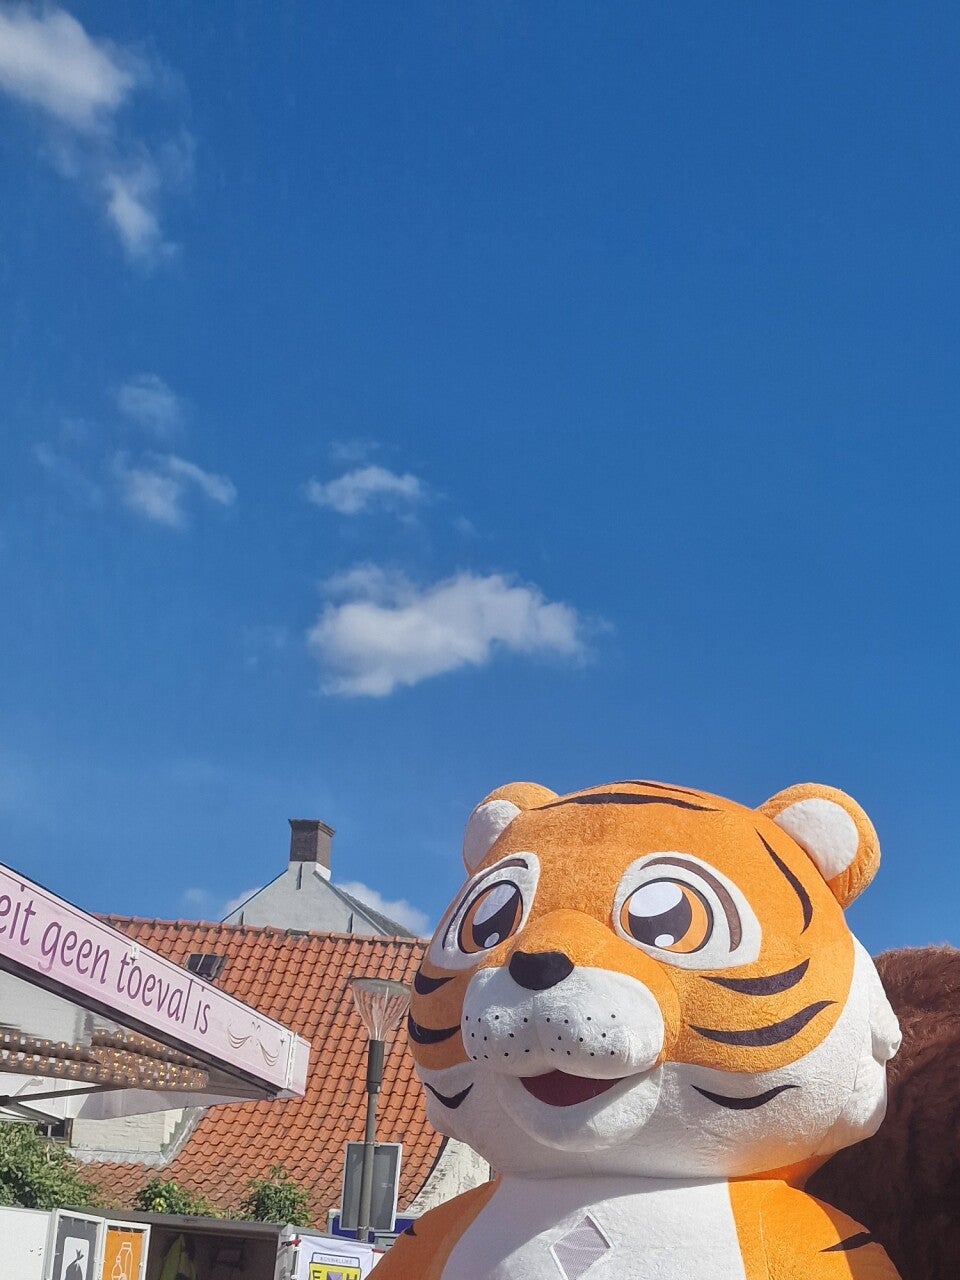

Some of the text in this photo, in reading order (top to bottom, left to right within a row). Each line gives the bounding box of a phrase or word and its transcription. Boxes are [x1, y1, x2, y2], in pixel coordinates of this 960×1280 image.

[38, 921, 110, 985] geen
[117, 952, 194, 1024] toeval
[193, 986, 211, 1035] is
